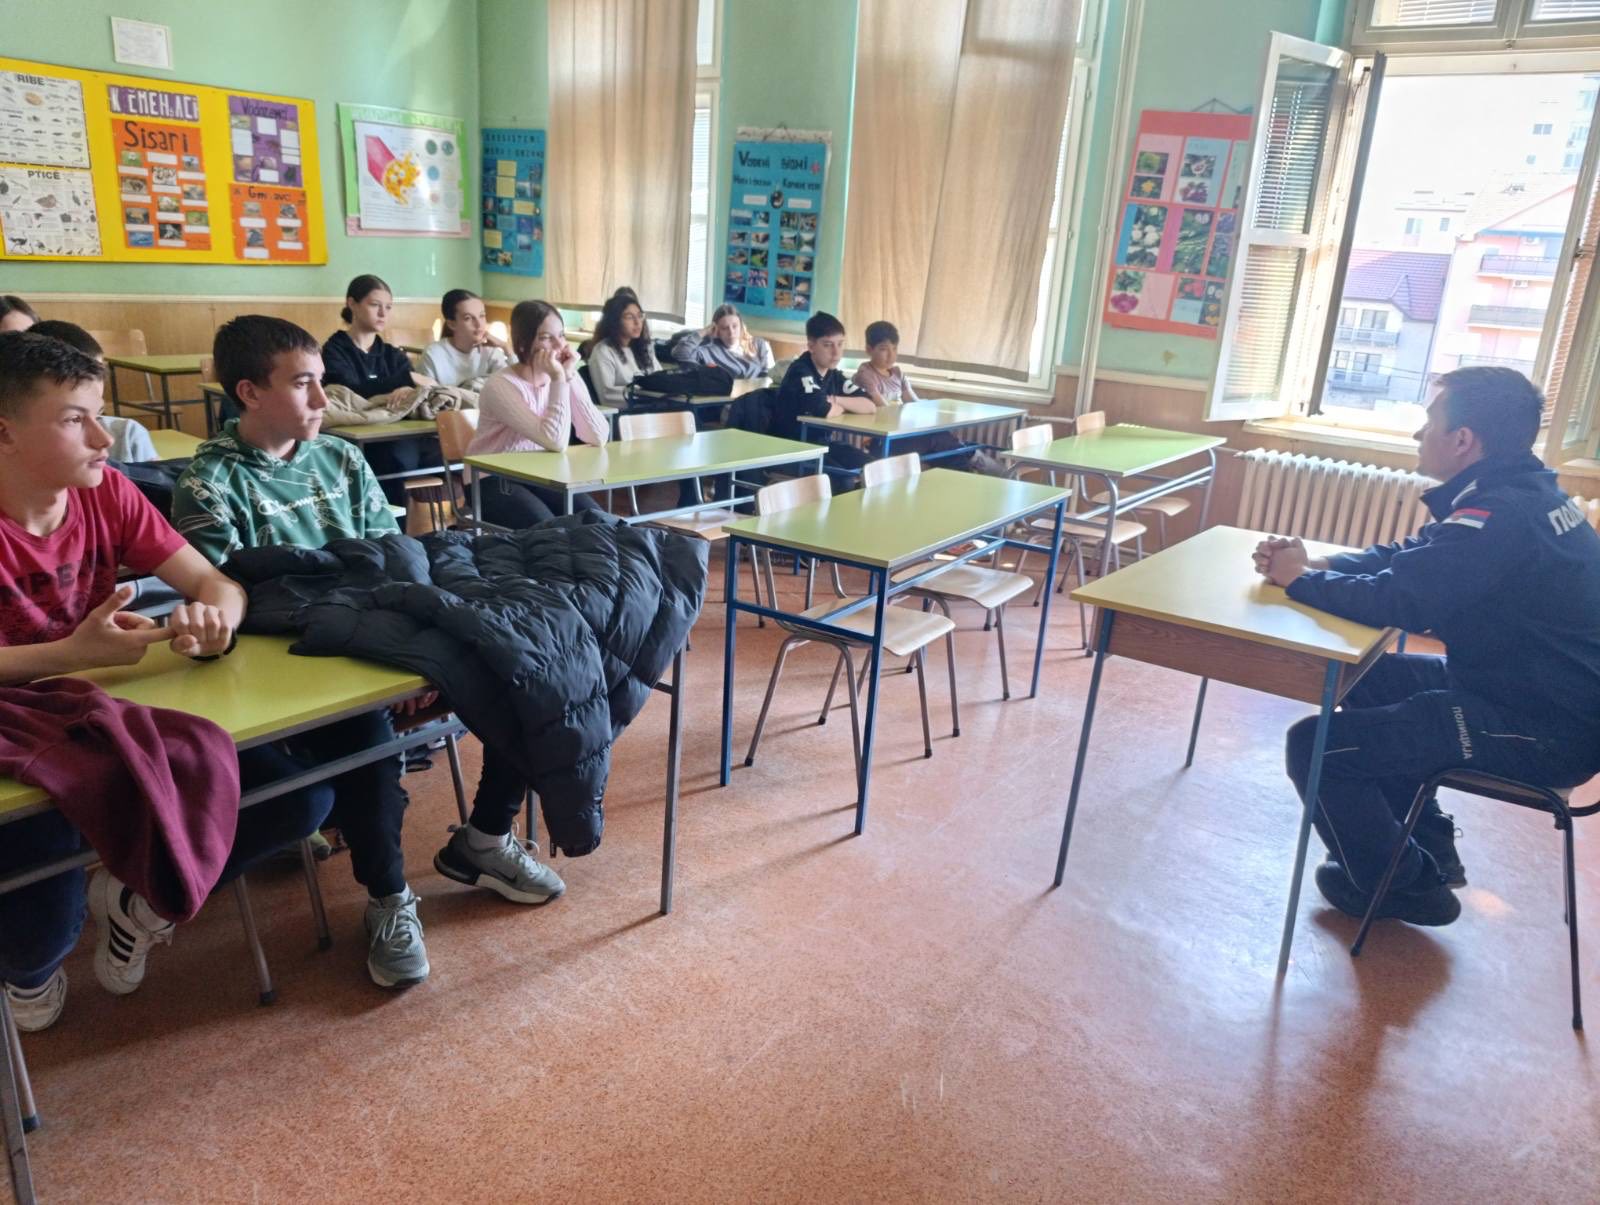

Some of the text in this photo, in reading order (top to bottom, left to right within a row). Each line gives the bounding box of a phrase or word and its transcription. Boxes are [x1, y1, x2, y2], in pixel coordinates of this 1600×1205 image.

[16, 74, 45, 86] RIBE
[124, 120, 188, 153] Sisari
[27, 170, 61, 180] PTICE
[1451, 706, 1473, 760] ПОЛИЦИЈА
